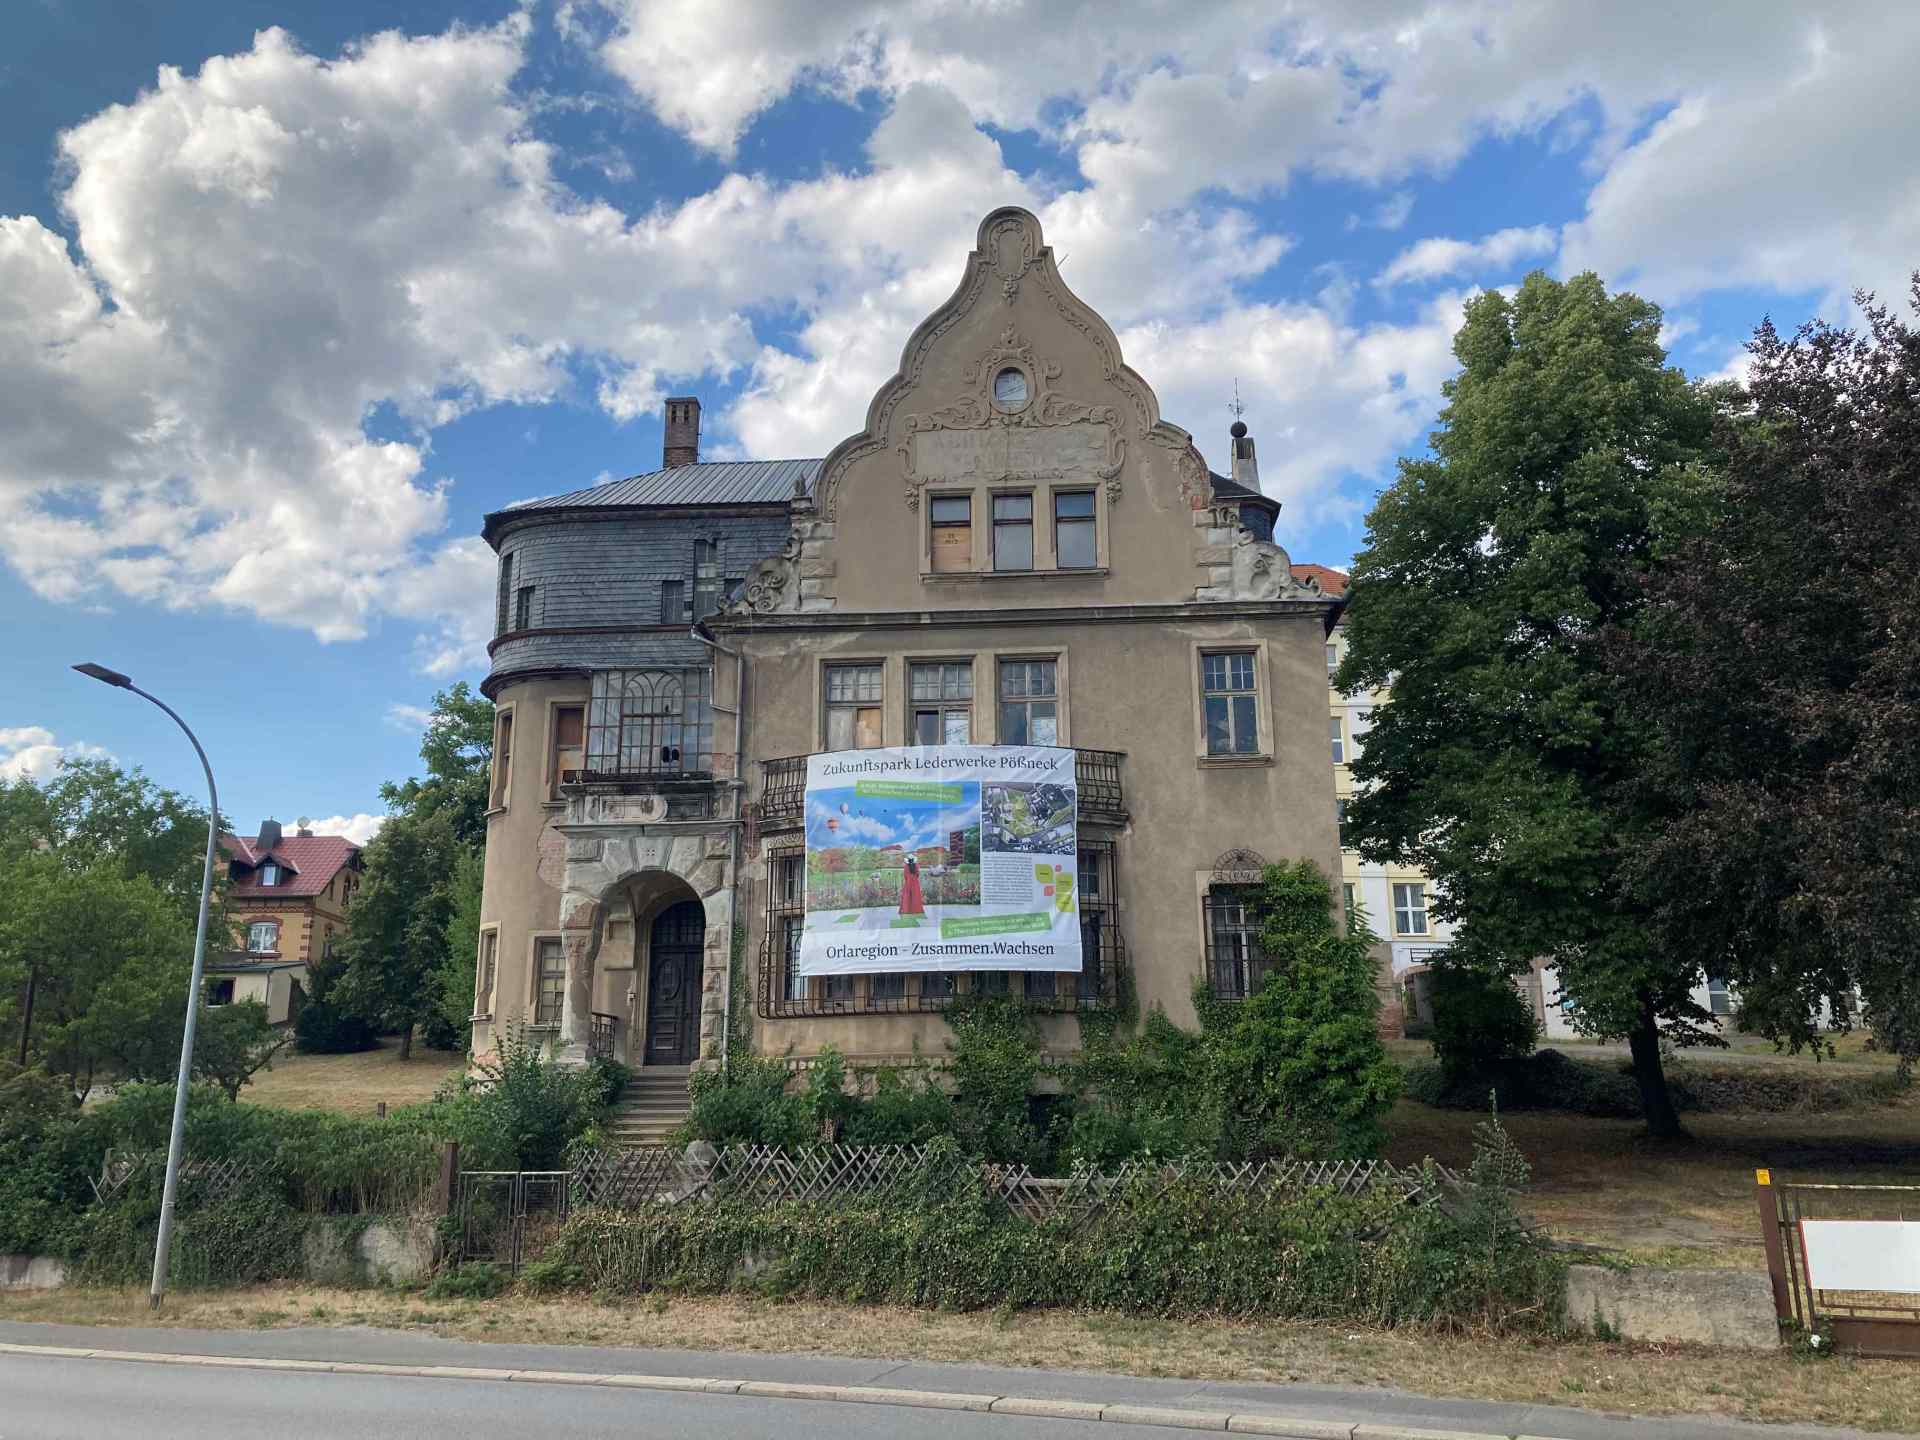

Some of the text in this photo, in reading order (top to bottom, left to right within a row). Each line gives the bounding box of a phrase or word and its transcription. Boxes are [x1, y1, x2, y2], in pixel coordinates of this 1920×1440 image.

[823, 755, 1059, 776] Zukunftspark Lederwerke Pößneck
[826, 943, 899, 961] Orlaregion
[911, 941, 1055, 956] Zusammen.Wachsen
